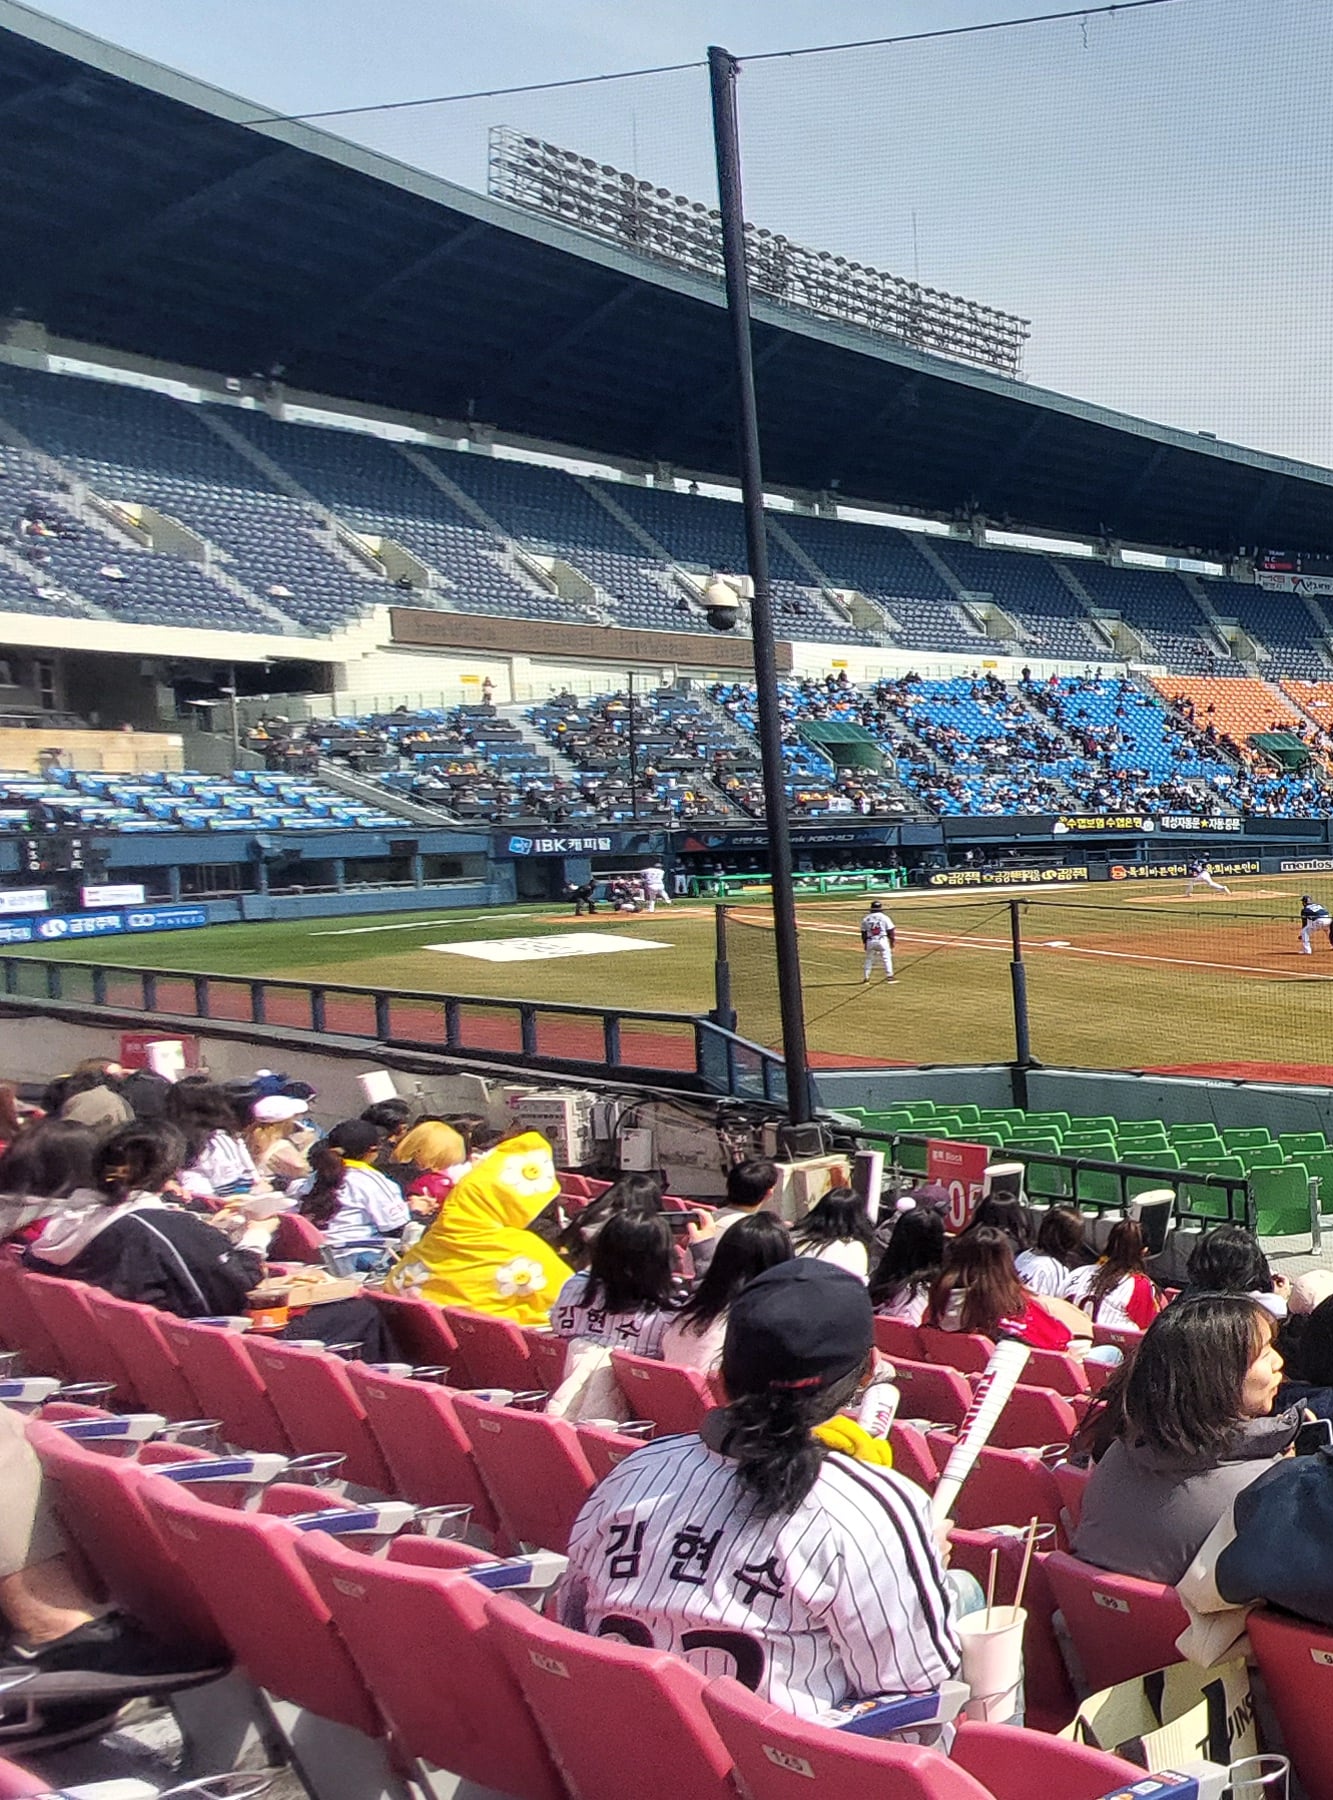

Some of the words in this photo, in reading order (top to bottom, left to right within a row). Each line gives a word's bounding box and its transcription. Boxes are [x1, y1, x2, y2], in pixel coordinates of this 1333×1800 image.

[1066, 816, 1105, 829] 수협보험
[1106, 816, 1143, 828] 수협은행
[1282, 860, 1333, 871] mentos
[948, 871, 981, 885] 금강주택
[1056, 867, 1088, 881] 금강주택
[557, 1305, 641, 1341] 김현수
[607, 1517, 788, 1605] 김현수
